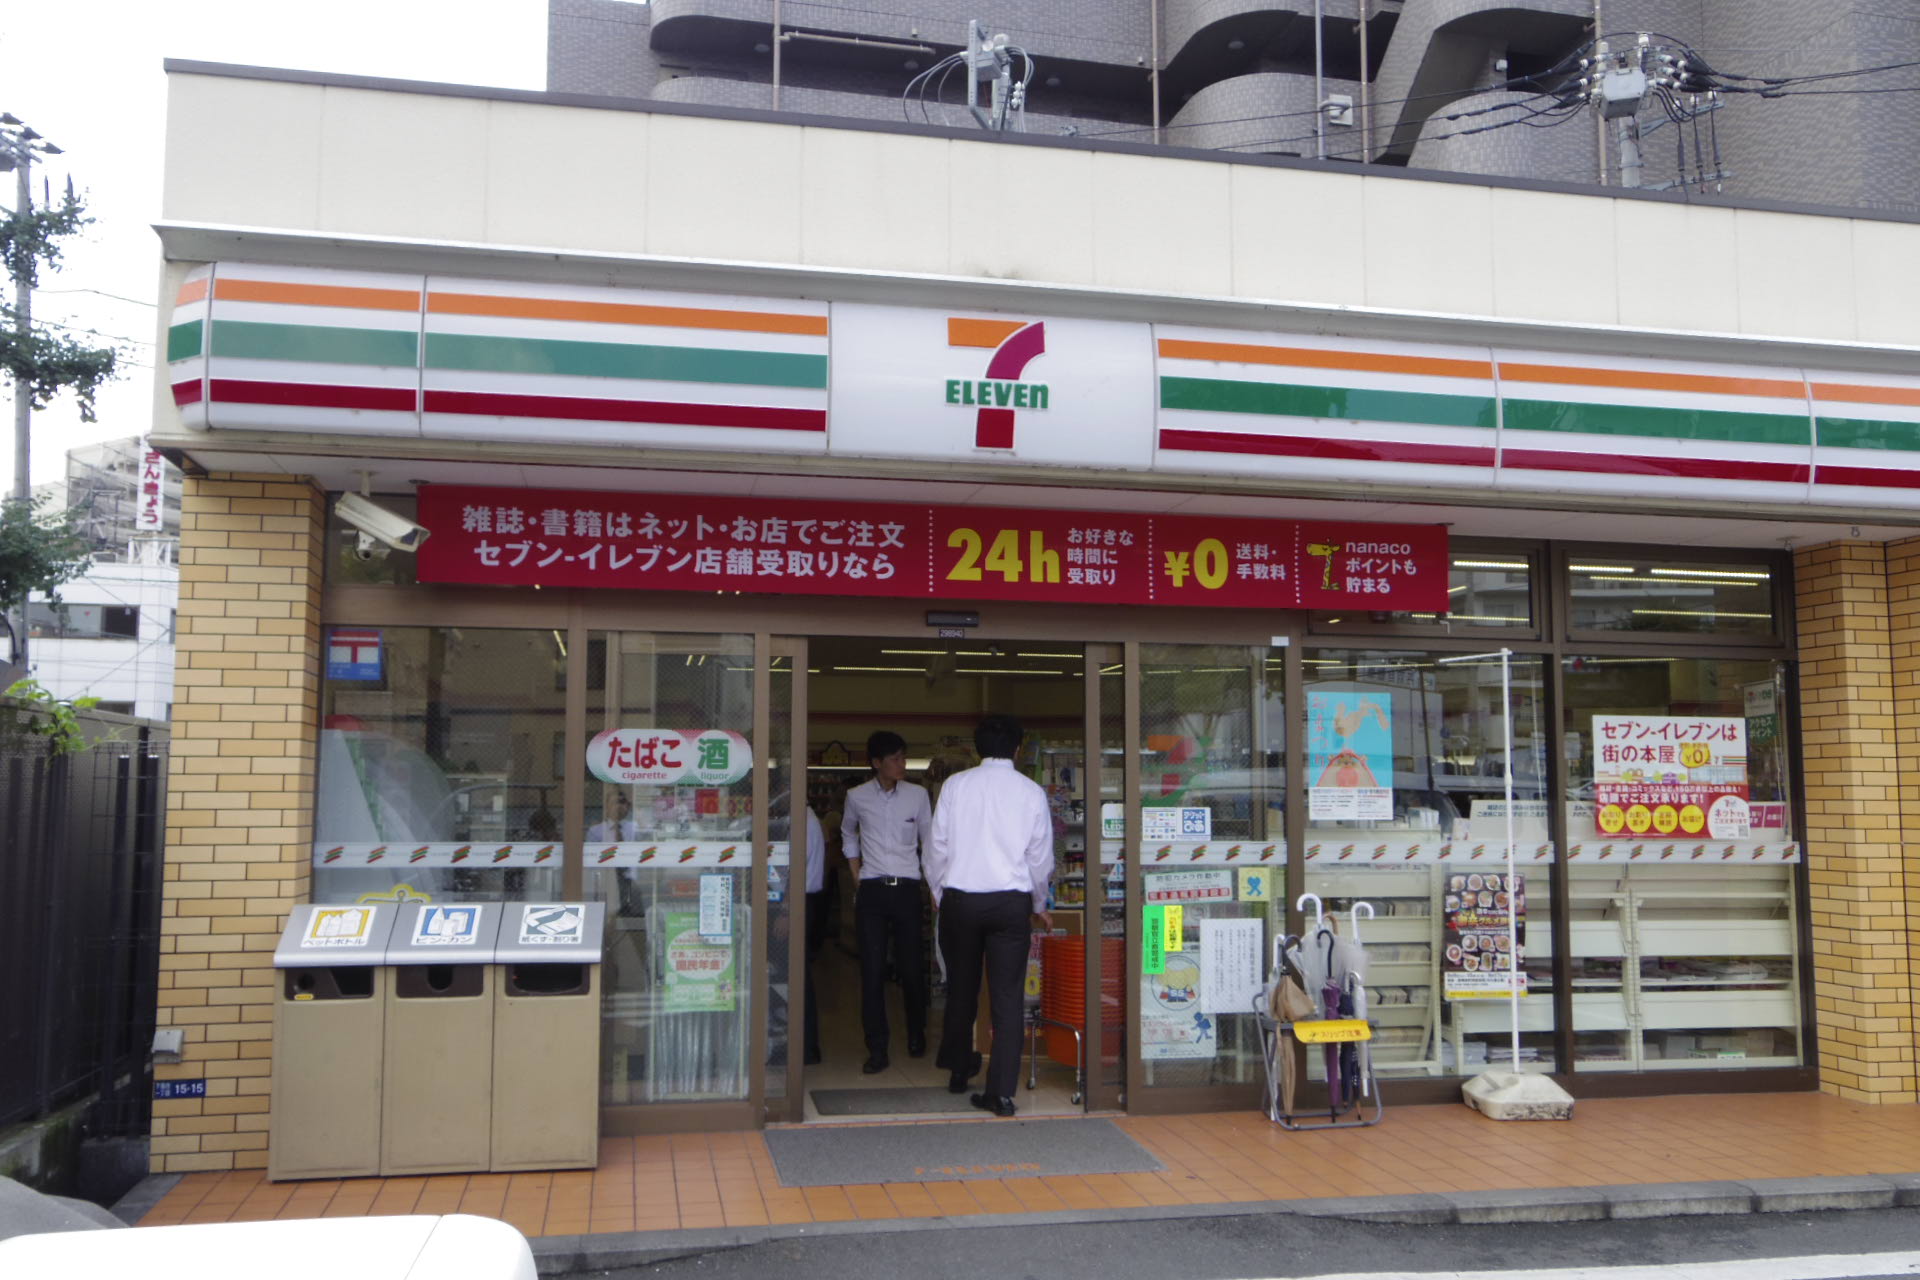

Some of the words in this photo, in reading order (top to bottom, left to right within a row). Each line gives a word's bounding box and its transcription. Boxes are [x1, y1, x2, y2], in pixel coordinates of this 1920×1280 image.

[462, 505, 906, 549] 雑誌・書籍はネット・お店でご注文
[1067, 528, 1134, 547] お好きな
[945, 527, 1061, 584] 24h
[1067, 547, 1118, 566] 時間に
[1346, 541, 1411, 556] nanaco
[474, 539, 895, 580] セブン-イレブン店舗受取りなら
[1164, 537, 1229, 590] ¥0
[1346, 556, 1417, 576] ポイントも
[1067, 567, 1117, 586] 受取り
[1236, 562, 1286, 581] 手数料
[1346, 576, 1391, 594] 貯まる
[1601, 721, 1738, 741] セブン-イレブンは
[608, 737, 682, 769] たばこ
[697, 738, 729, 769] 酒
[1602, 745, 1675, 764] 街の本屋
[622, 771, 668, 781] cigarette
[700, 771, 730, 780] liquor
